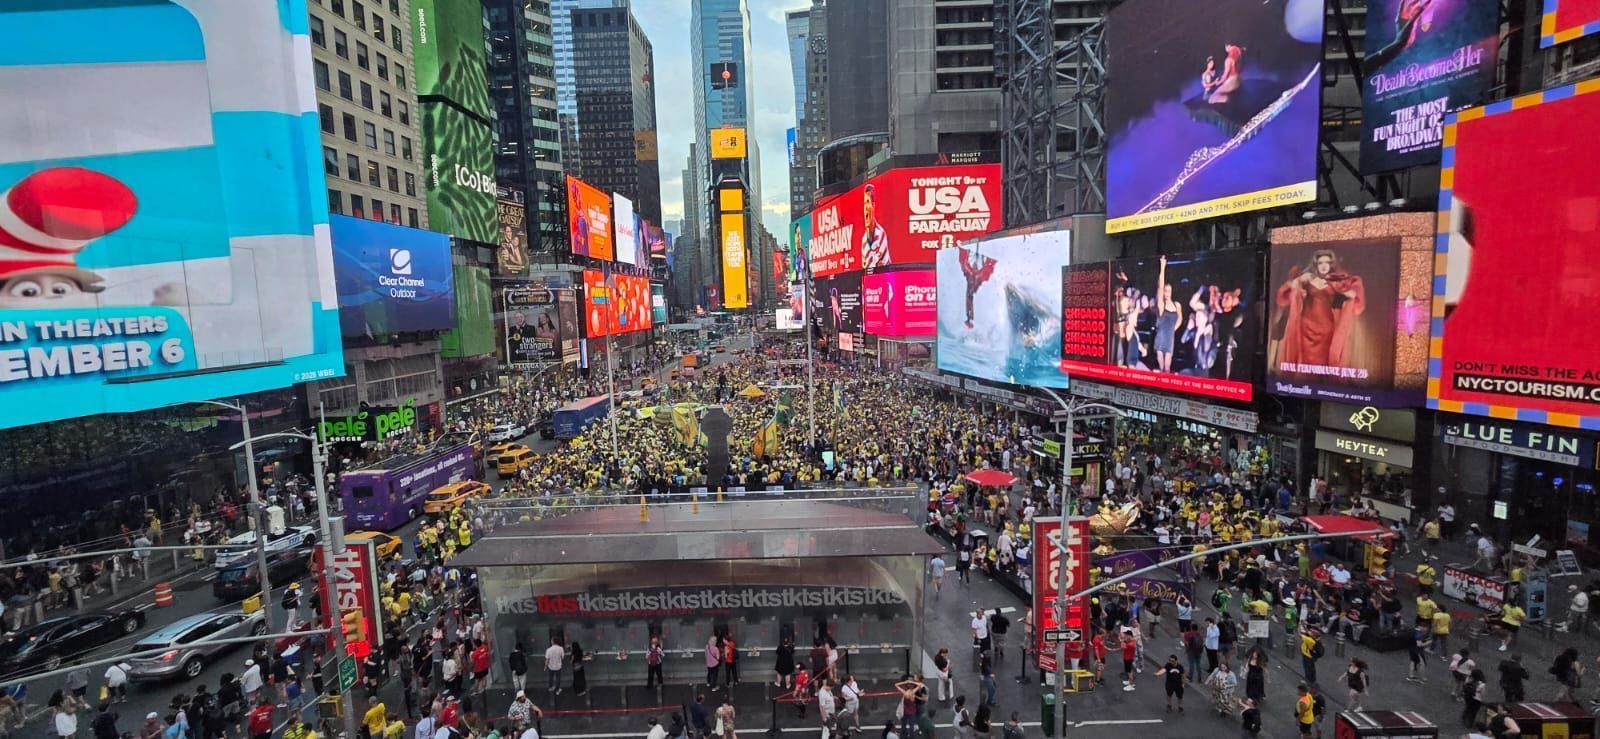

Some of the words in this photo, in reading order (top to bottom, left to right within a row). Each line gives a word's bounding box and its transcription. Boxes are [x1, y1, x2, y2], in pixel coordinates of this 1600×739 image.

[418, 8, 426, 44] seed.com
[1370, 72, 1406, 95] Death
[1406, 62, 1458, 86] Becomes
[1454, 45, 1484, 71] Her
[1391, 105, 1415, 122] THE
[1418, 96, 1448, 114] MOST
[1374, 124, 1394, 142] FUN
[1395, 116, 1427, 134] NIGHT
[1386, 126, 1442, 151] BROADWA
[911, 176, 962, 187] TONIGHT
[908, 186, 990, 214] USA
[1140, 217, 1152, 225] BOX
[1153, 213, 1174, 223] OFFICE
[1180, 209, 1197, 217] 42ND
[1198, 205, 1214, 215] AND
[1233, 199, 1250, 209] SKIP
[1252, 195, 1272, 206] FEES
[1275, 190, 1306, 201] TODAY.
[818, 204, 840, 234] USA
[909, 219, 990, 234] PARAGUAY
[809, 224, 853, 260] PARAGUAY
[922, 240, 939, 249] FOX
[379, 275, 397, 286] Clear
[399, 276, 424, 287] Channel
[390, 288, 416, 298] Outdoor
[1065, 308, 1106, 319] CHICAGO
[35, 316, 168, 339] THEATERS
[1065, 320, 1106, 332] CHICAGO
[1065, 332, 1106, 344] CHICAGO
[162, 338, 184, 364] 6
[1065, 344, 1106, 357] CHICAGO
[1280, 362, 1296, 372] FINAL
[1297, 362, 1340, 376] PERFORMANCE
[1341, 368, 1356, 378] JUNE
[1454, 361, 1496, 373] DON'T
[1501, 365, 1539, 376] MISS
[1545, 367, 1577, 379] THE
[1216, 385, 1237, 393] OFFICE
[317, 411, 368, 444] pelé
[376, 396, 414, 442] pelé
[1336, 438, 1385, 456] HEYTEA
[1446, 423, 1513, 444] BLUE
[1528, 432, 1578, 454] FIN
[1530, 450, 1577, 463] SUSHI
[334, 548, 362, 609] tkts
[1144, 580, 1176, 599] Aladdin
